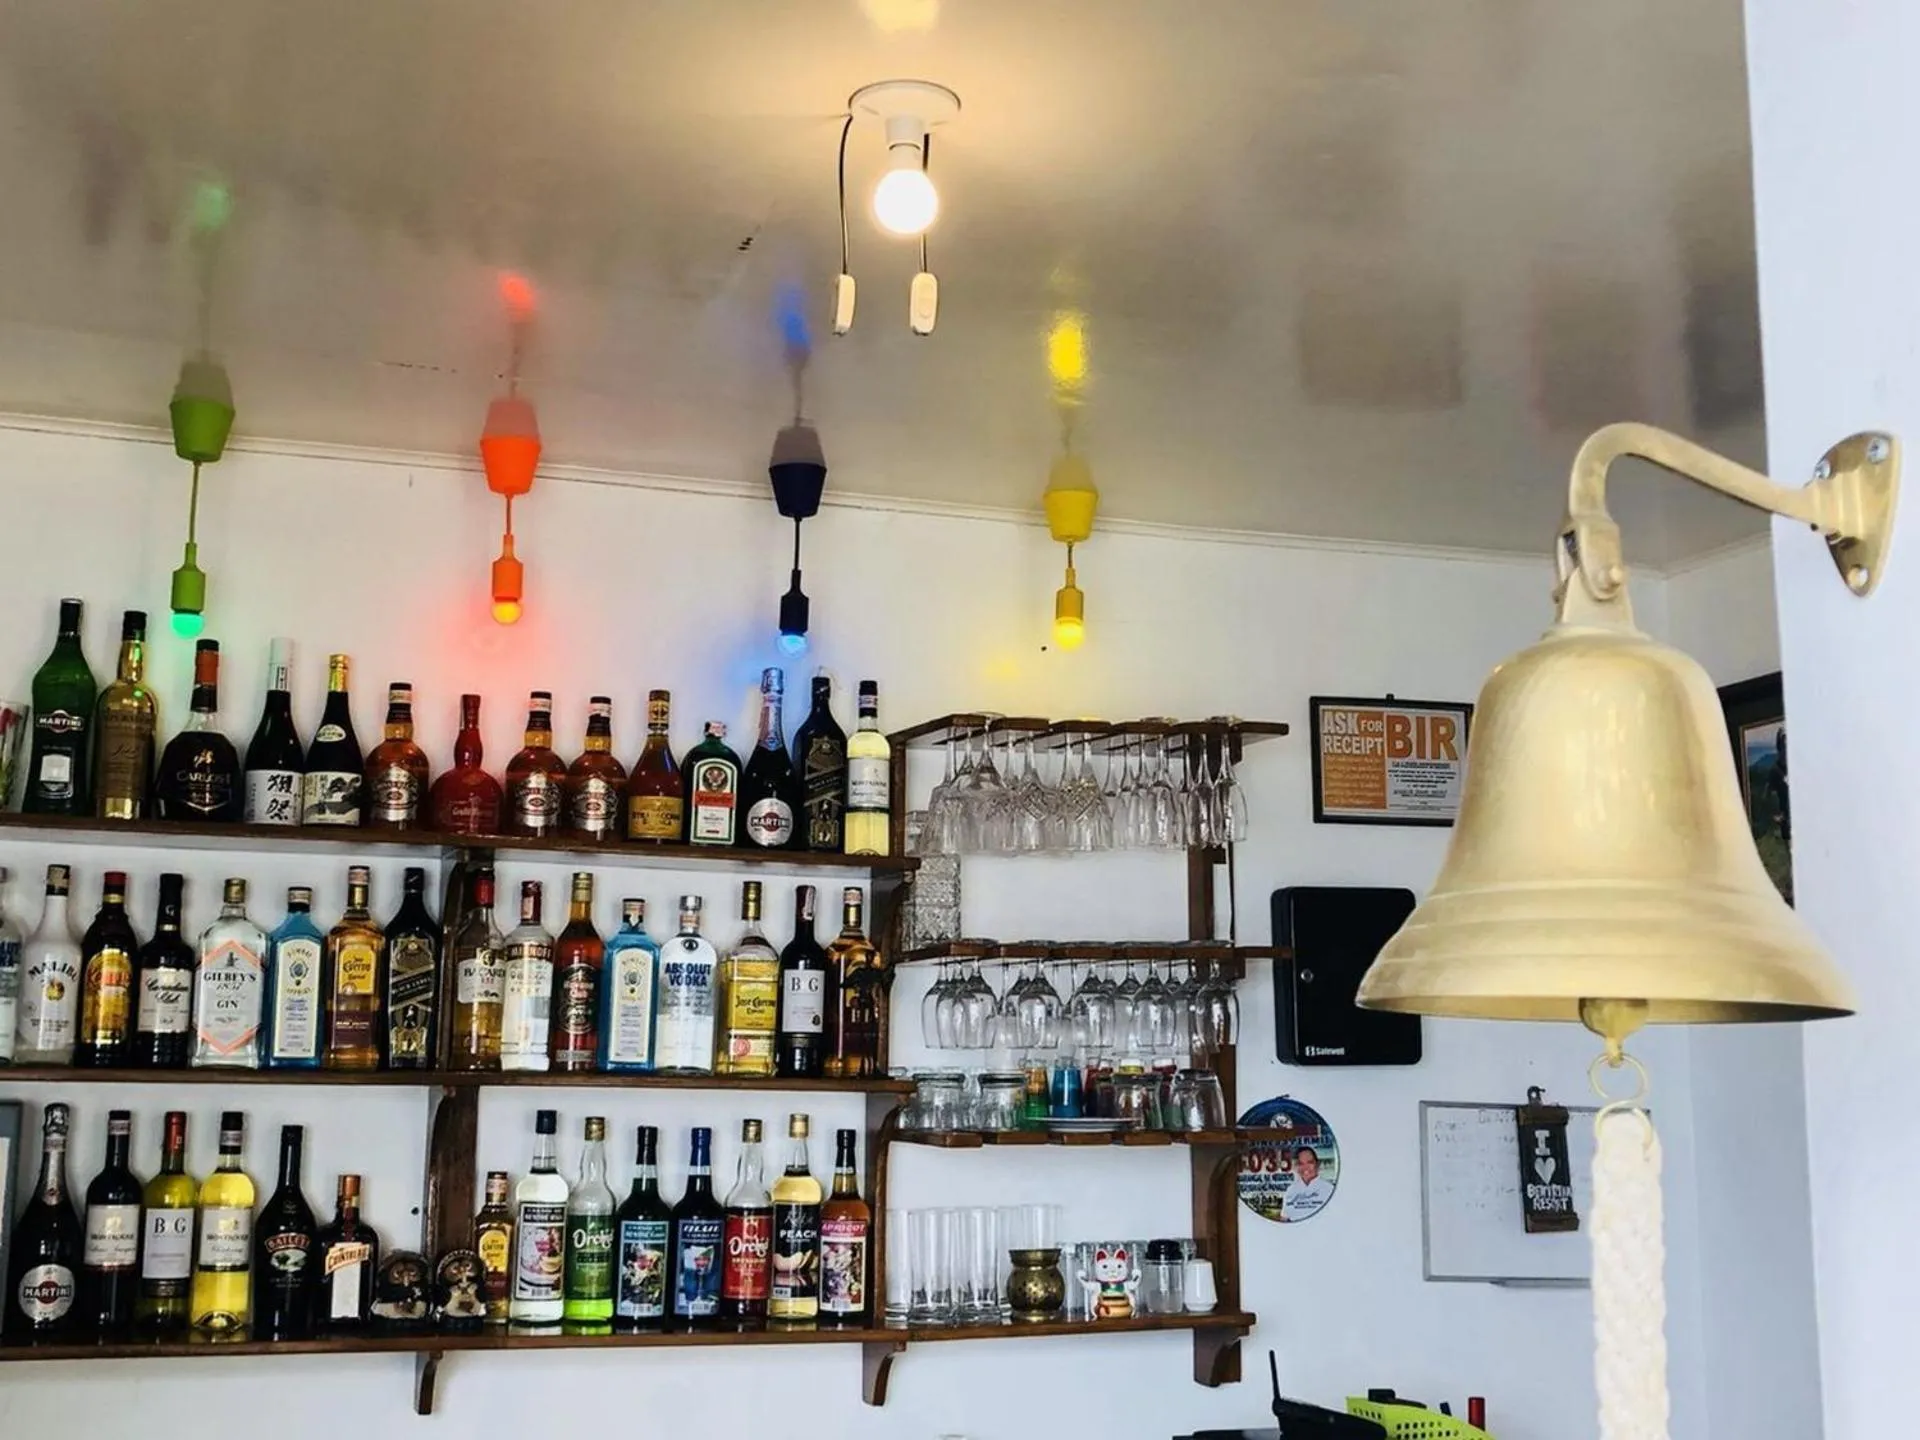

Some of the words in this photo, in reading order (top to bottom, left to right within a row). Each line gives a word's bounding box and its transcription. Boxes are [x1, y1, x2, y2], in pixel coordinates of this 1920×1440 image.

[39, 717, 82, 728] MARTINI
[1323, 711, 1359, 735] ASK
[1360, 719, 1383, 733] FOR
[1387, 714, 1458, 761] BIR
[1323, 736, 1384, 757] RECEIPT
[752, 816, 791, 827] MARTINI
[28, 960, 79, 983] MALIBU
[665, 962, 712, 975] ABSOLUT
[669, 974, 708, 987] VODKA
[216, 1000, 239, 1009] GIN
[1534, 1129, 1551, 1157] I
[780, 1229, 818, 1239] PEACH
[25, 1287, 71, 1298] MARTINI
